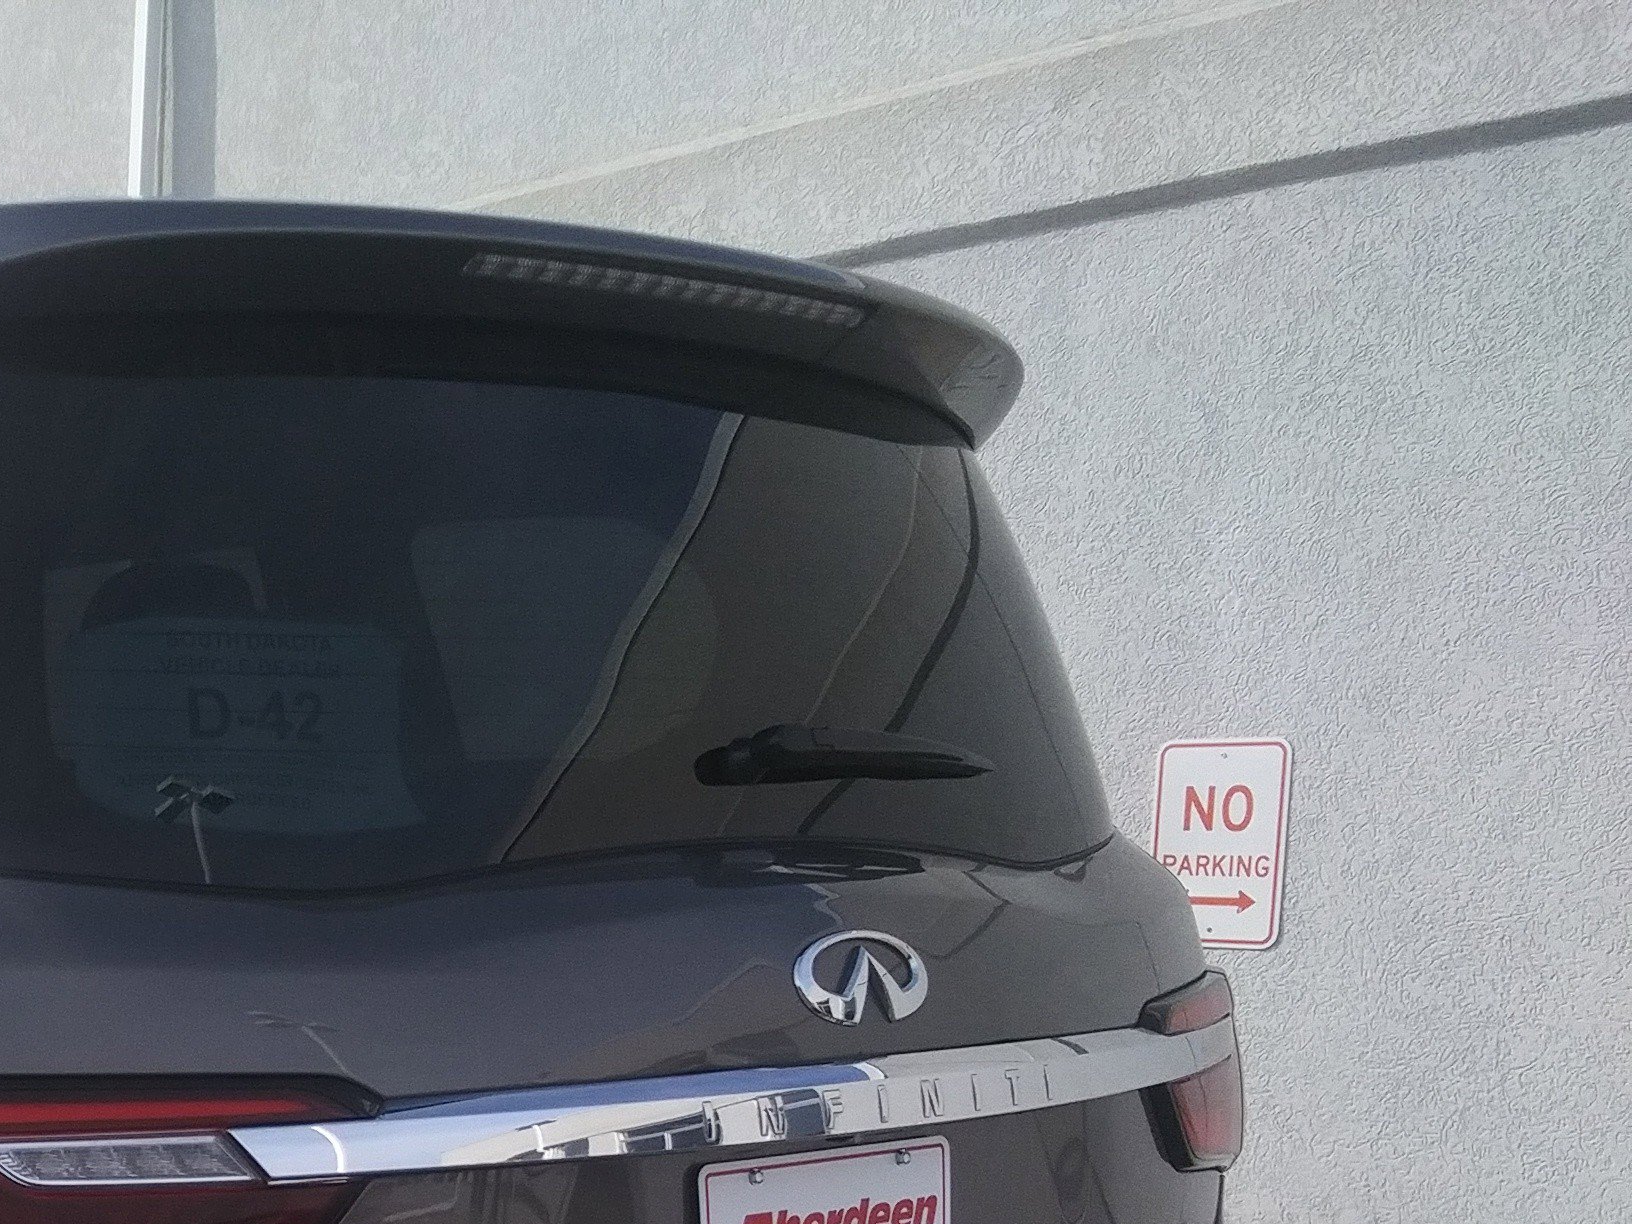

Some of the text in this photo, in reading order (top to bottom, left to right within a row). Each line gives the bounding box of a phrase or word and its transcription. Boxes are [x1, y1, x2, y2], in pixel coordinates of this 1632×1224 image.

[187, 686, 324, 744] D-42
[1182, 784, 1255, 832] NO
[1162, 854, 1270, 878] PARKING
[702, 1063, 1055, 1143] INFINITI
